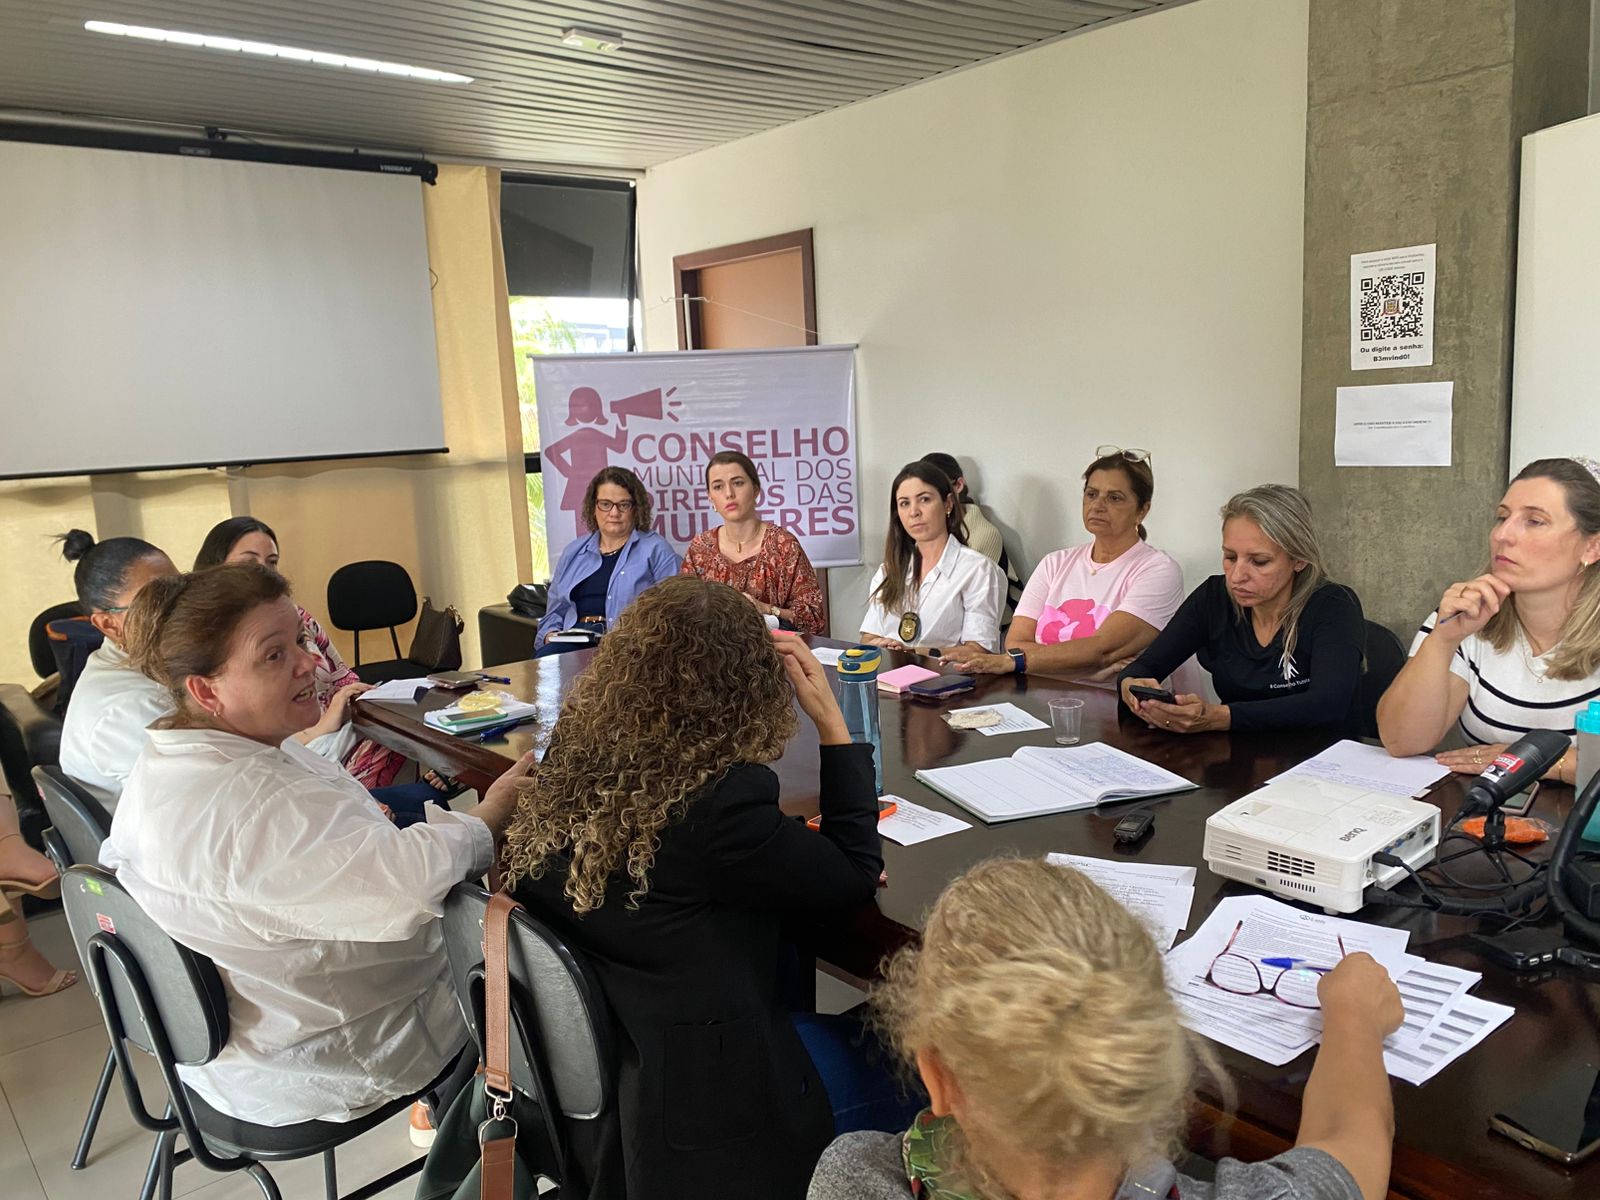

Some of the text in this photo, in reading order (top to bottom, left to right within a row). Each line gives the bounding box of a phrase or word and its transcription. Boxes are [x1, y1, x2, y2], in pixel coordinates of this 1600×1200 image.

[1371, 345, 1391, 353] digite
[632, 426, 849, 464] CONSELHO
[633, 457, 852, 488] MUNIAL DOS
[646, 481, 854, 512] IRES DAS
[650, 505, 856, 543] ULERES
[1339, 827, 1368, 842] BenQ
